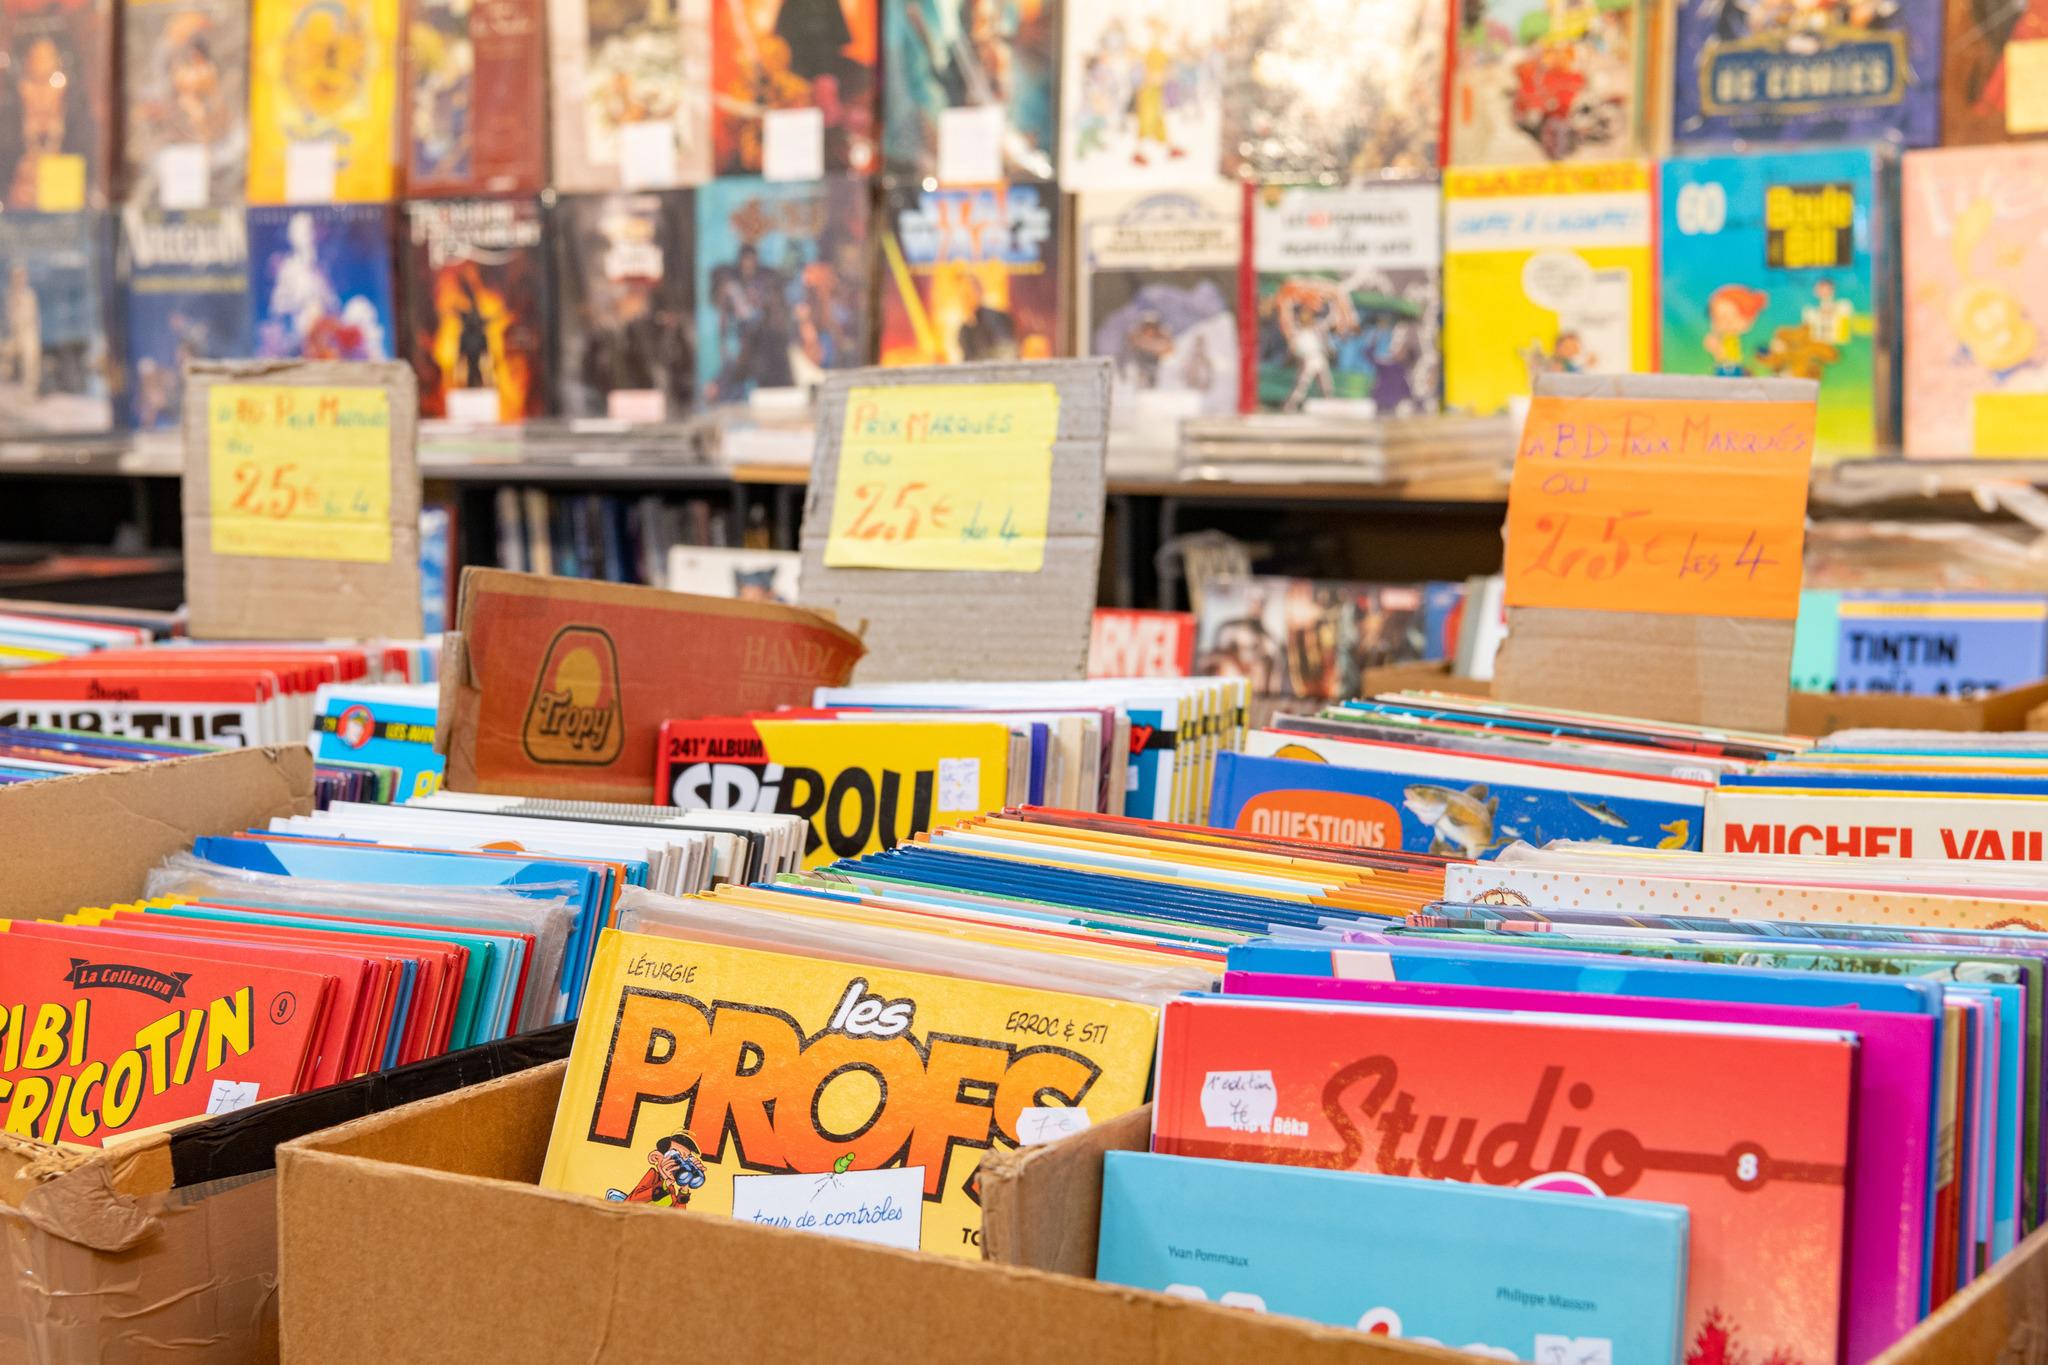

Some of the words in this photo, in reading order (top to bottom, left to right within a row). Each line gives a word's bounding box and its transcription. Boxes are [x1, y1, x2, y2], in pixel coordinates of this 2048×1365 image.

[1735, 529, 1780, 581] 4
[1089, 613, 1182, 679] RVEL
[1849, 631, 1959, 664] TINTIN
[540, 689, 613, 750] Tropy
[707, 739, 764, 758] ALBUM
[1251, 808, 1385, 849] QUESTIONS
[79, 970, 97, 985] La
[101, 968, 172, 996] Collection
[627, 953, 698, 984] LÉTURGIE
[831, 977, 914, 1036] les
[1006, 1011, 1059, 1037] ERROC
[1063, 1020, 1075, 1042] &
[0, 998, 91, 1073] IBI
[0, 986, 254, 1145] RICOTIN
[587, 986, 1103, 1207] PROFS
[1321, 1054, 1645, 1197] Studio
[1737, 1153, 1758, 1181] 8
[796, 1210, 817, 1227] de
[819, 1196, 903, 1225] contrôles
[1168, 1245, 1194, 1262] Yvan
[1195, 1248, 1250, 1268] Pommaux
